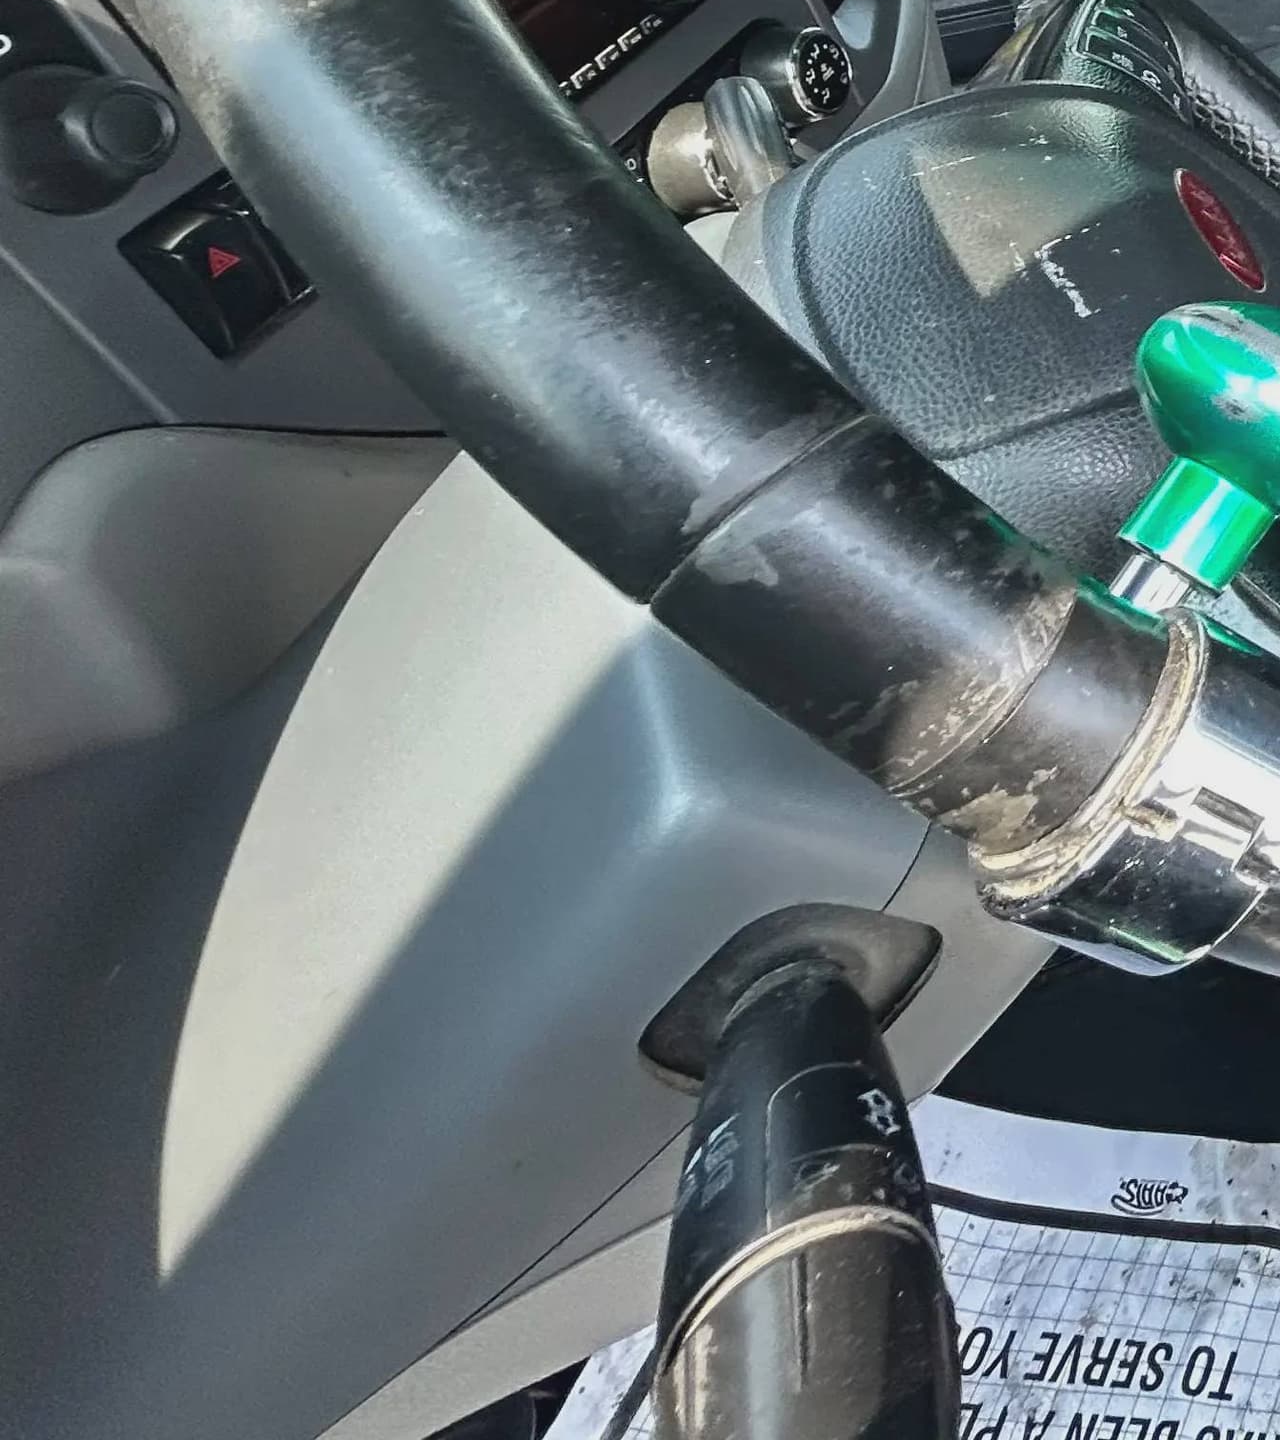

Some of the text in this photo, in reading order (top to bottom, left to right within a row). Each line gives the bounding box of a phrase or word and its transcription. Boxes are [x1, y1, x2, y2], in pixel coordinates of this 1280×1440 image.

[960, 1326, 1238, 1401] TO SERVE YO
[959, 1401, 1008, 1440] PL
